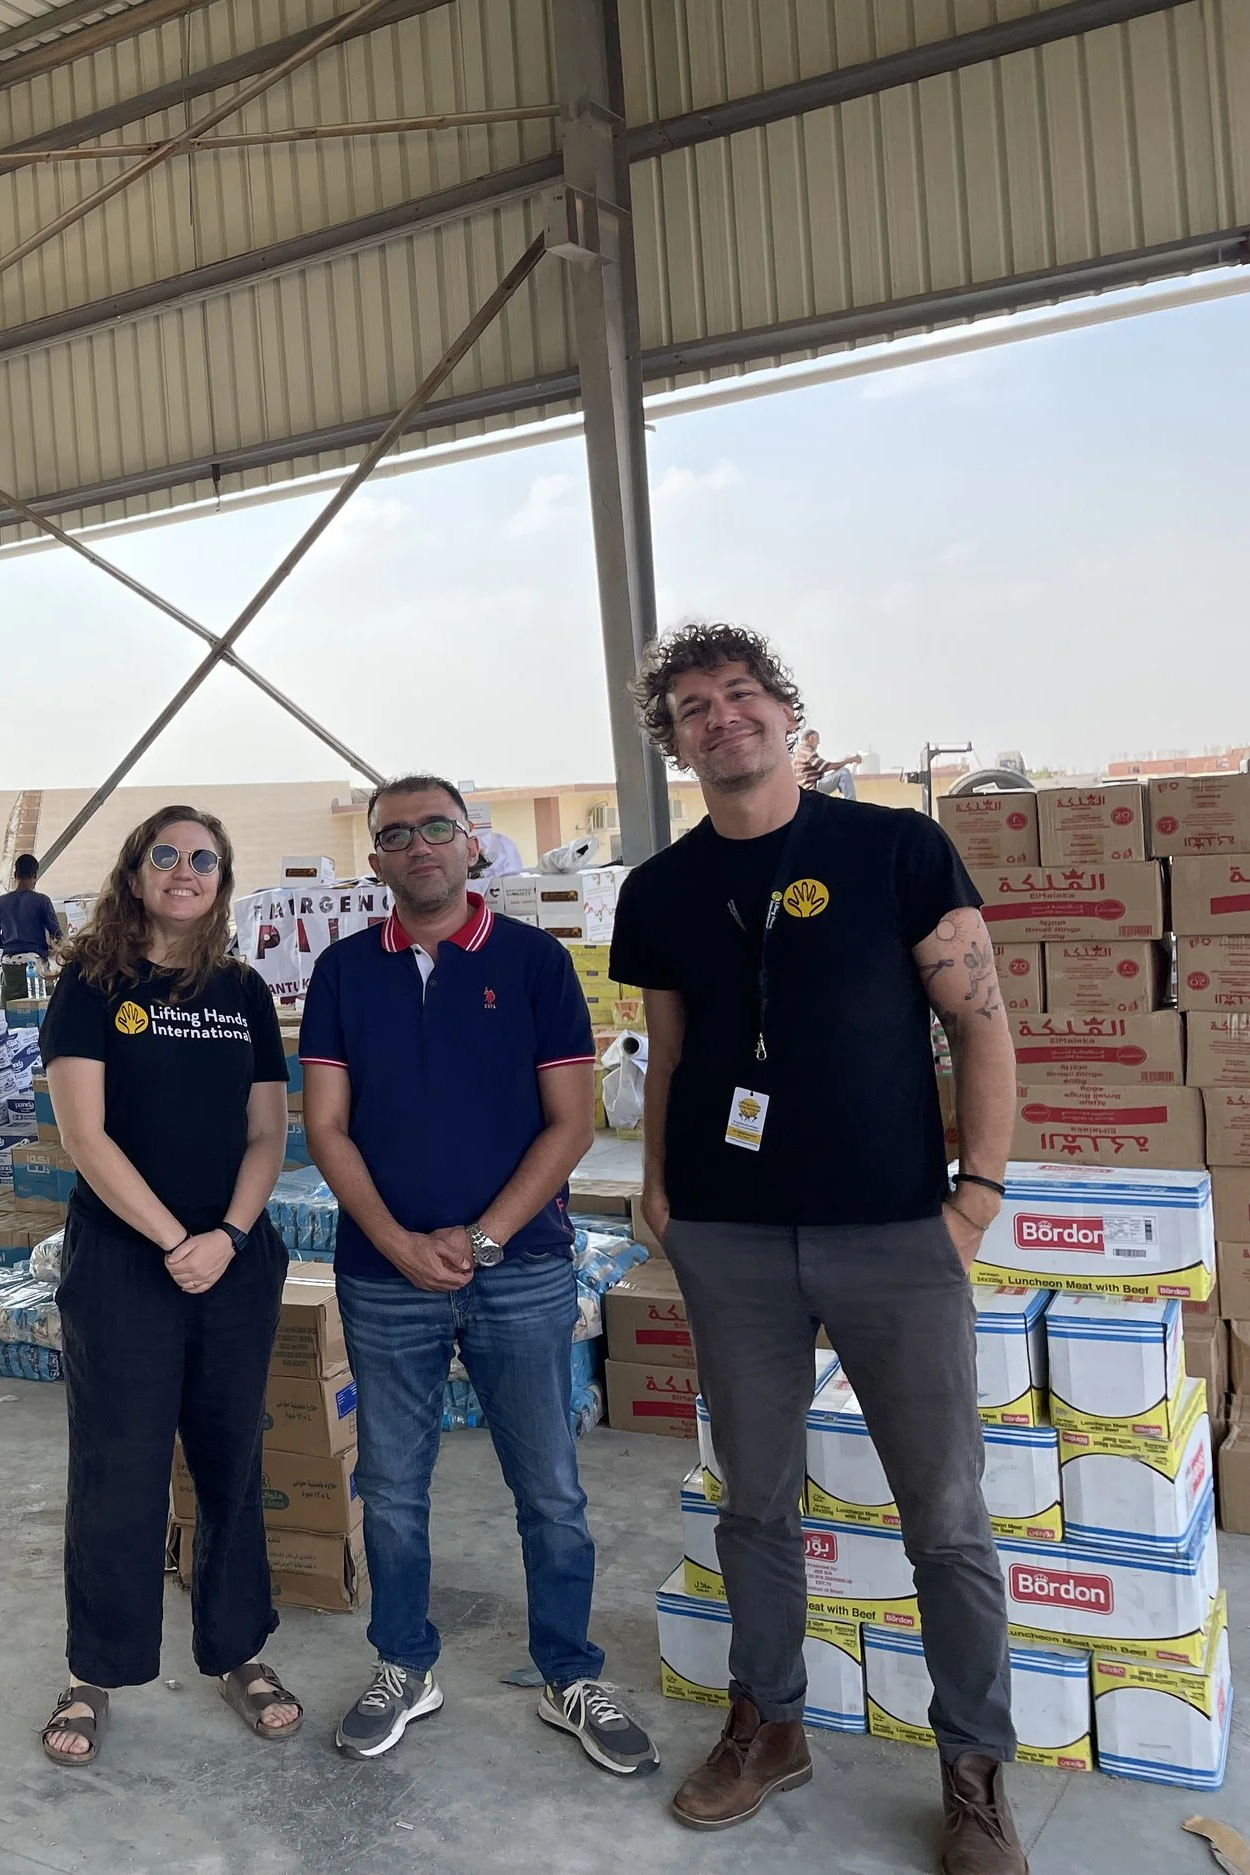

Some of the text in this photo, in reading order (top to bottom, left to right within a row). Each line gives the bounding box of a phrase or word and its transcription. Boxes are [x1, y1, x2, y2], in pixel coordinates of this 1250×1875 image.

[999, 873, 1105, 892] الملكة
[150, 1005, 248, 1027] Lifting Hands
[151, 1021, 251, 1043] International
[1019, 1019, 1126, 1037] الملكة
[1040, 1133, 1149, 1152] الملكة
[1008, 1276, 1062, 1288] Luncheon
[1066, 1281, 1092, 1290] Meat
[1095, 1282, 1119, 1293] with
[1122, 1285, 1150, 1295] Beef
[1018, 1573, 1105, 1604] Bordon
[808, 1602, 824, 1612] eat
[827, 1605, 849, 1616] with
[852, 1608, 877, 1620] Beef
[1062, 1638, 1089, 1647] Meat
[1092, 1642, 1117, 1652] with
[1121, 1647, 1147, 1657] Beef
